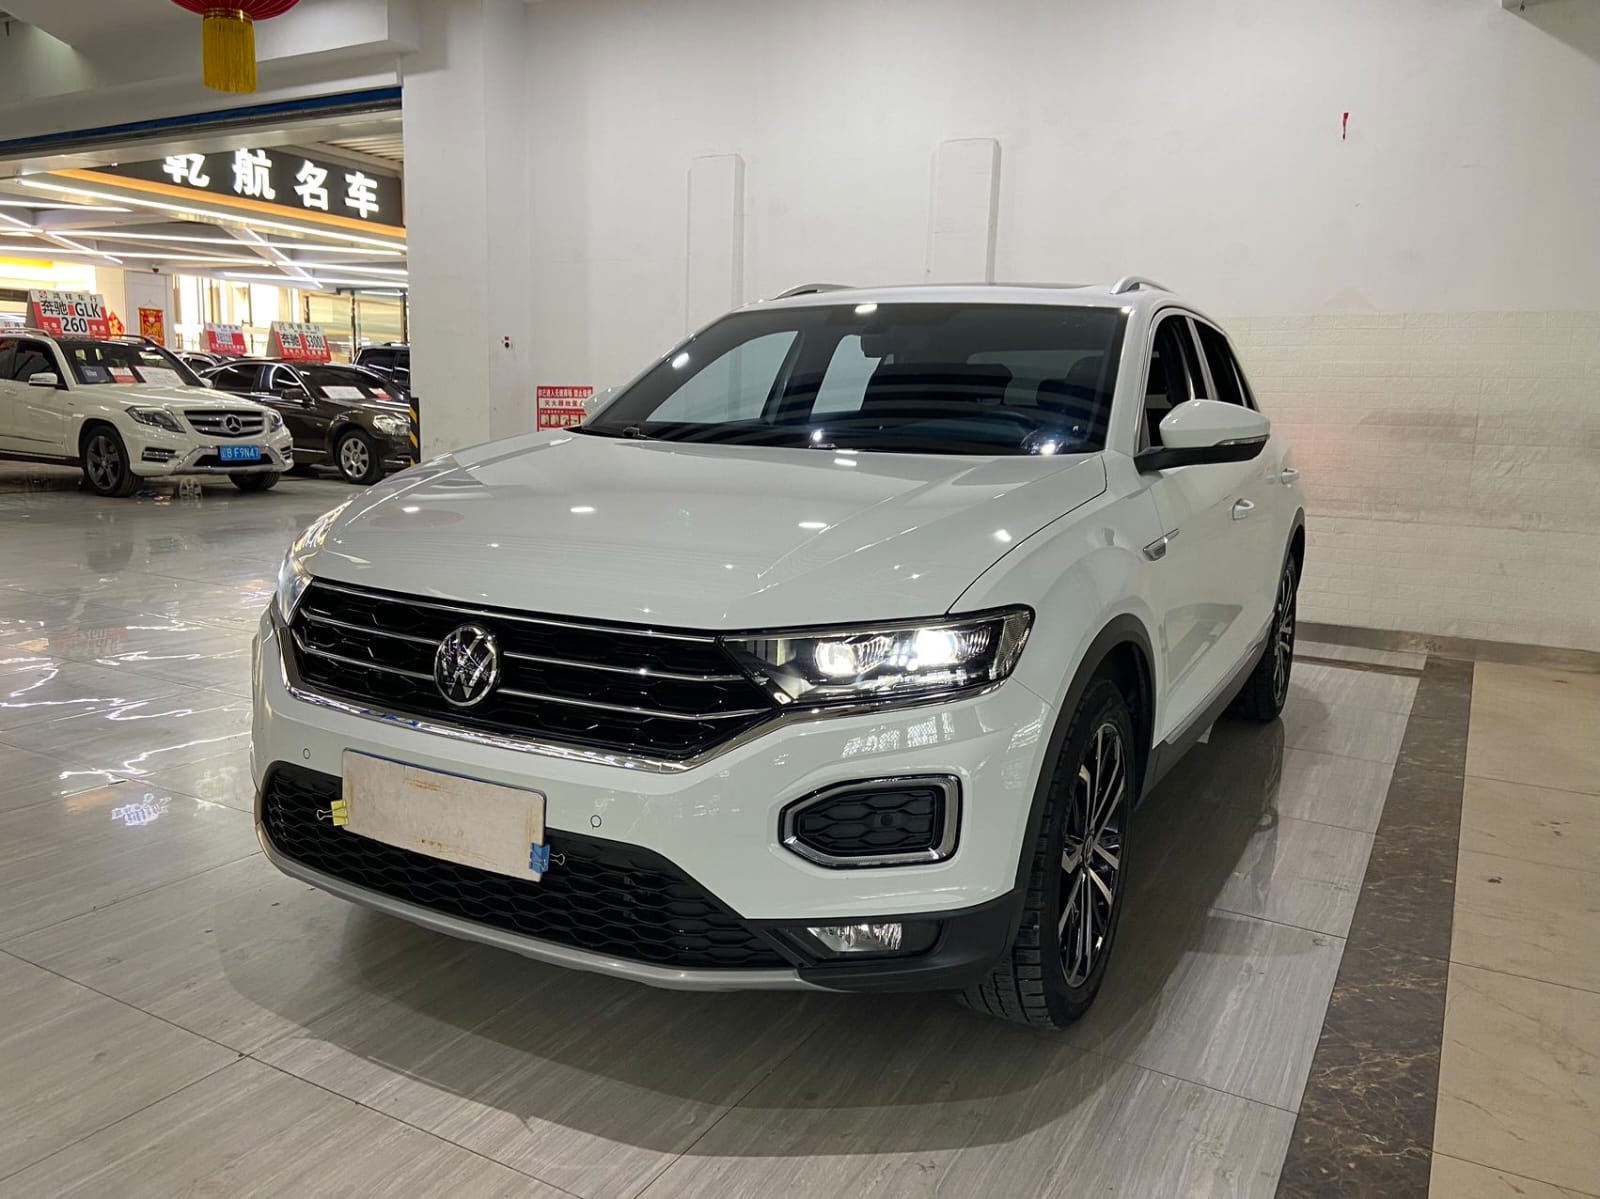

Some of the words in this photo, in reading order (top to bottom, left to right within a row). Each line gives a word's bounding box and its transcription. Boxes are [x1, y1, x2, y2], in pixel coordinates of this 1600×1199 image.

[41, 300, 69, 316] 奔驰
[75, 302, 102, 318] GLK
[62, 317, 88, 333] 260
